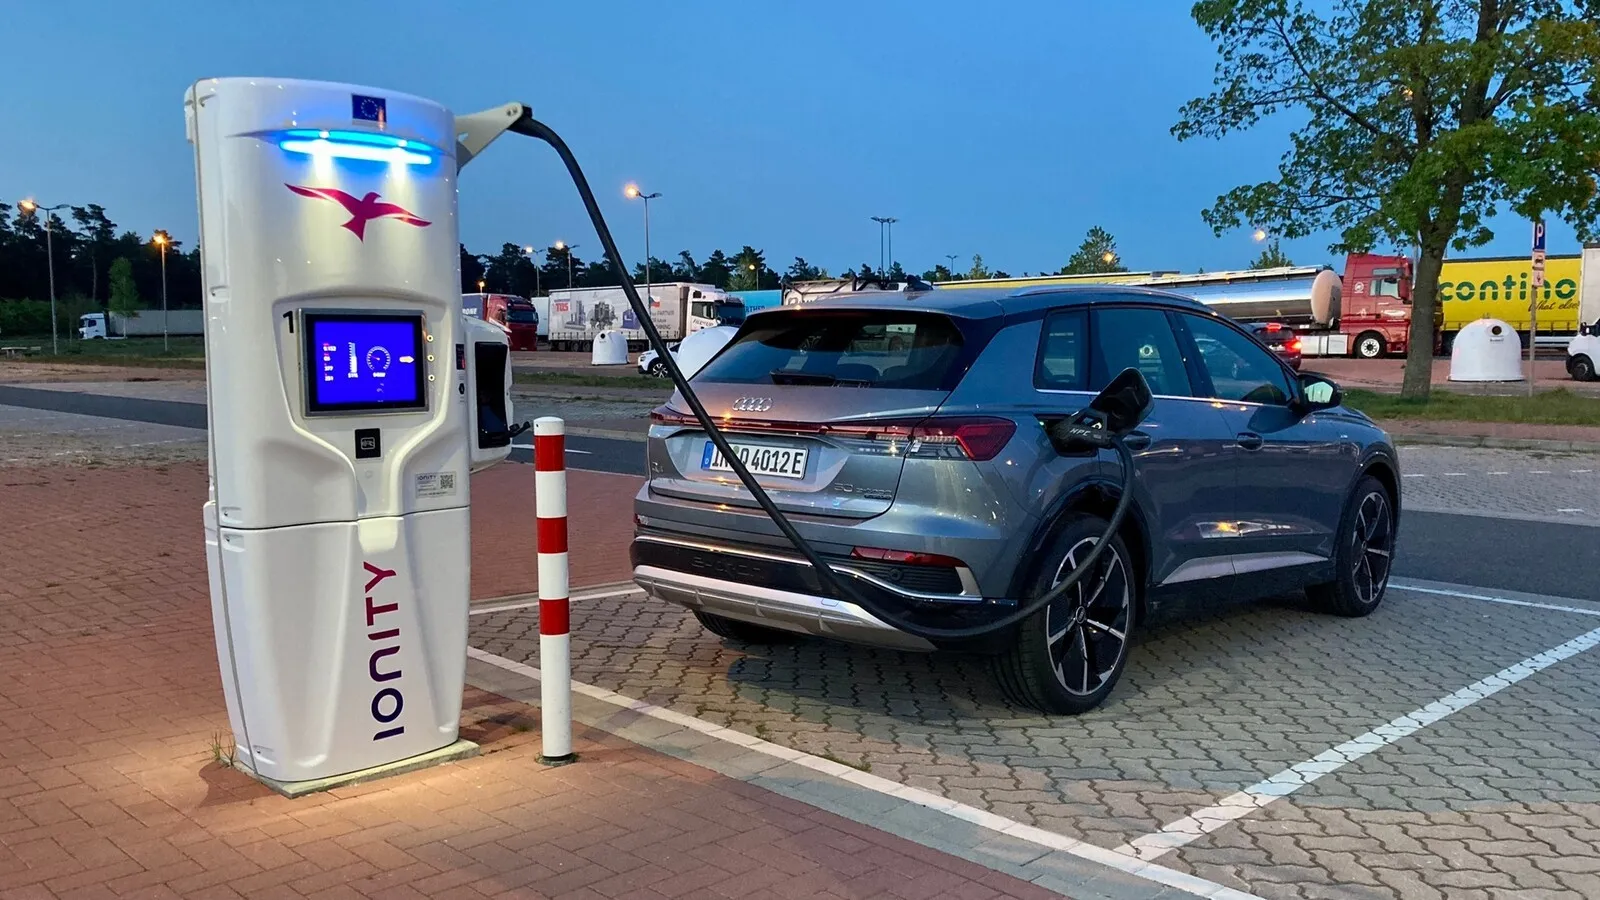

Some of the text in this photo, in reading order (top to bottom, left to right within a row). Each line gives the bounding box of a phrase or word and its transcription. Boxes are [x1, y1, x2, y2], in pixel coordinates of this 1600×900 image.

[283, 311, 294, 333] 1
[751, 449, 803, 475] 4012E
[363, 561, 405, 741] IONITY
